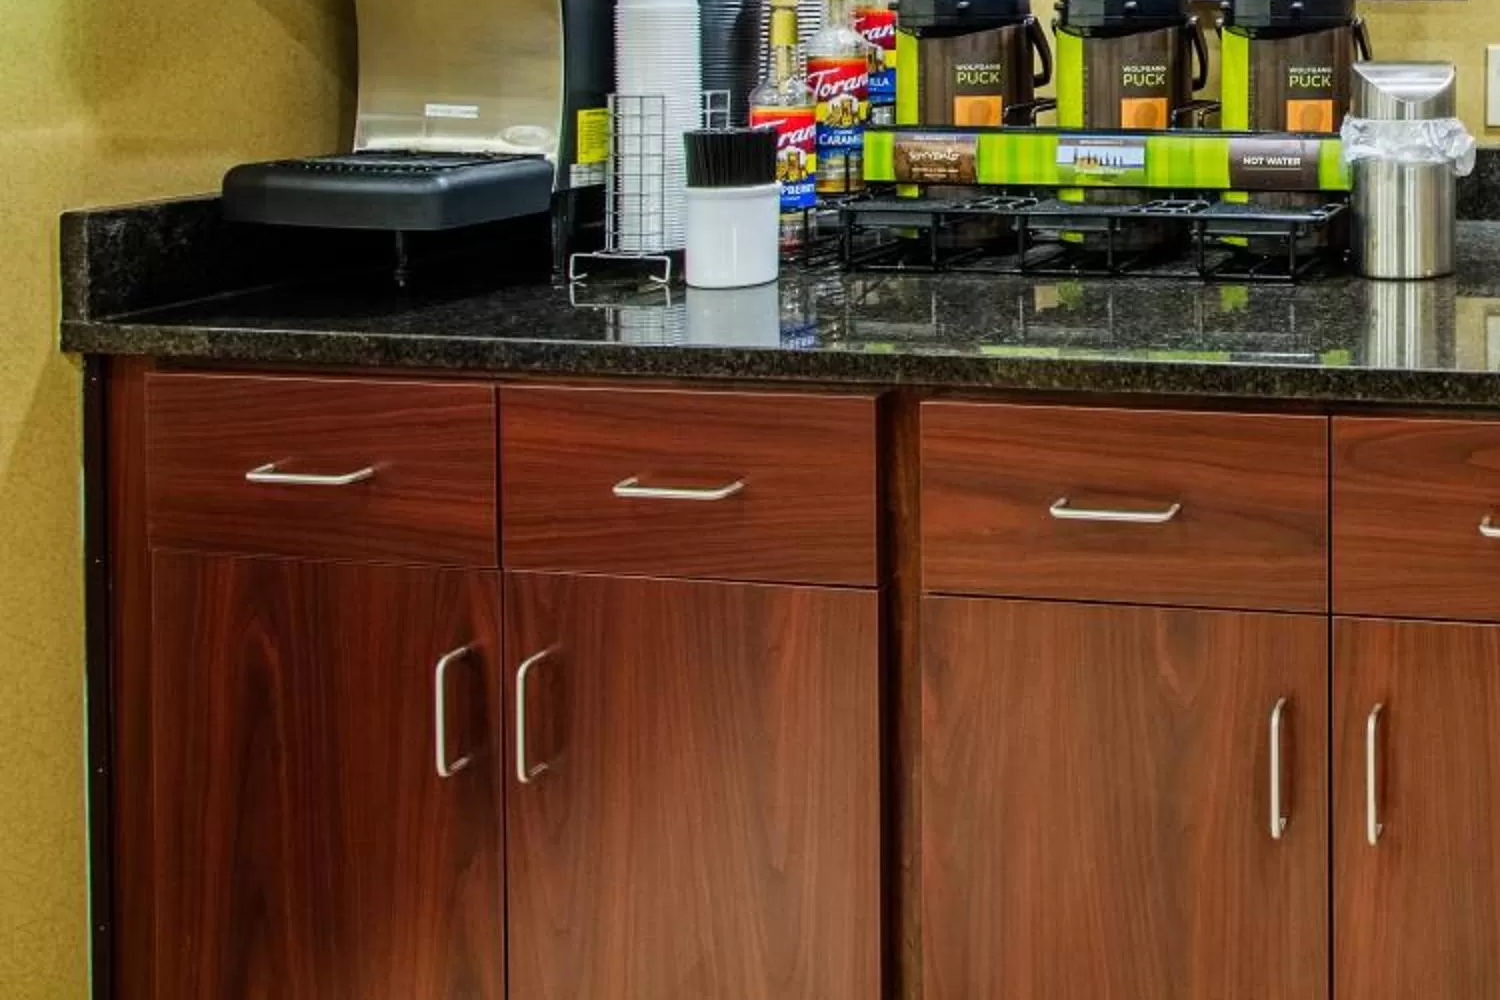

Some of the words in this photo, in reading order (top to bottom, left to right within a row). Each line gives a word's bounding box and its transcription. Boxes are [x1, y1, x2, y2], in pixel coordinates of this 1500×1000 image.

[956, 72, 999, 84] PUCK
[1124, 74, 1165, 86] PUCK
[1290, 75, 1331, 87] PUCK
[1243, 155, 1264, 165] HOT
[1266, 156, 1301, 165] WATER
